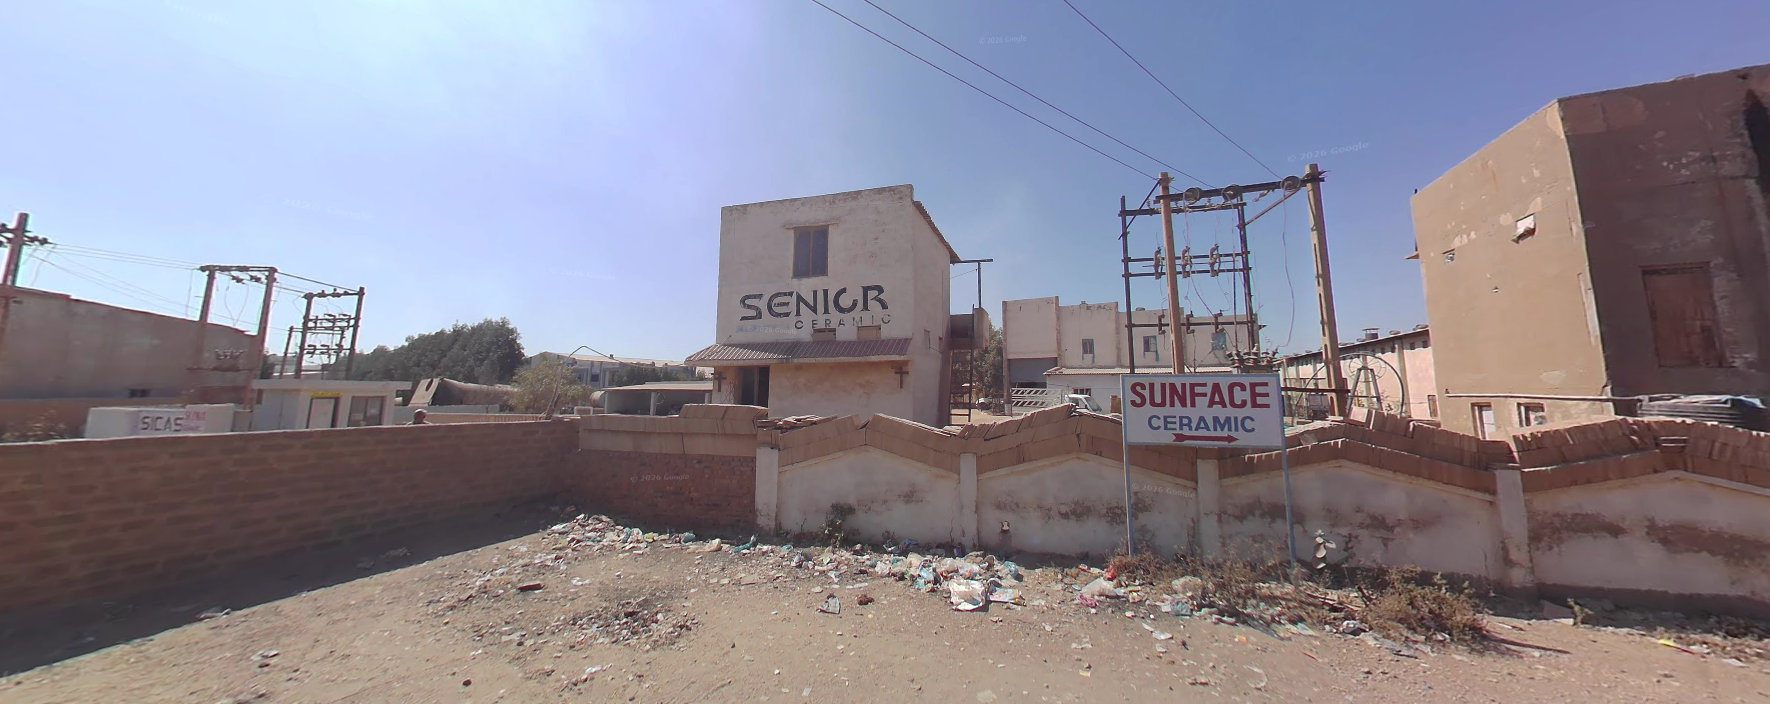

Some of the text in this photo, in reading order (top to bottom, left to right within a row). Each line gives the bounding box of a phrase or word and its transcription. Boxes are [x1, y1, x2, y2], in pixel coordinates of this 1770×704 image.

[794, 313, 892, 330] CERAMIC
[1130, 381, 1271, 409] SUNFACE
[140, 416, 184, 432] SICAS
[1147, 414, 1256, 433] CERAMIC
